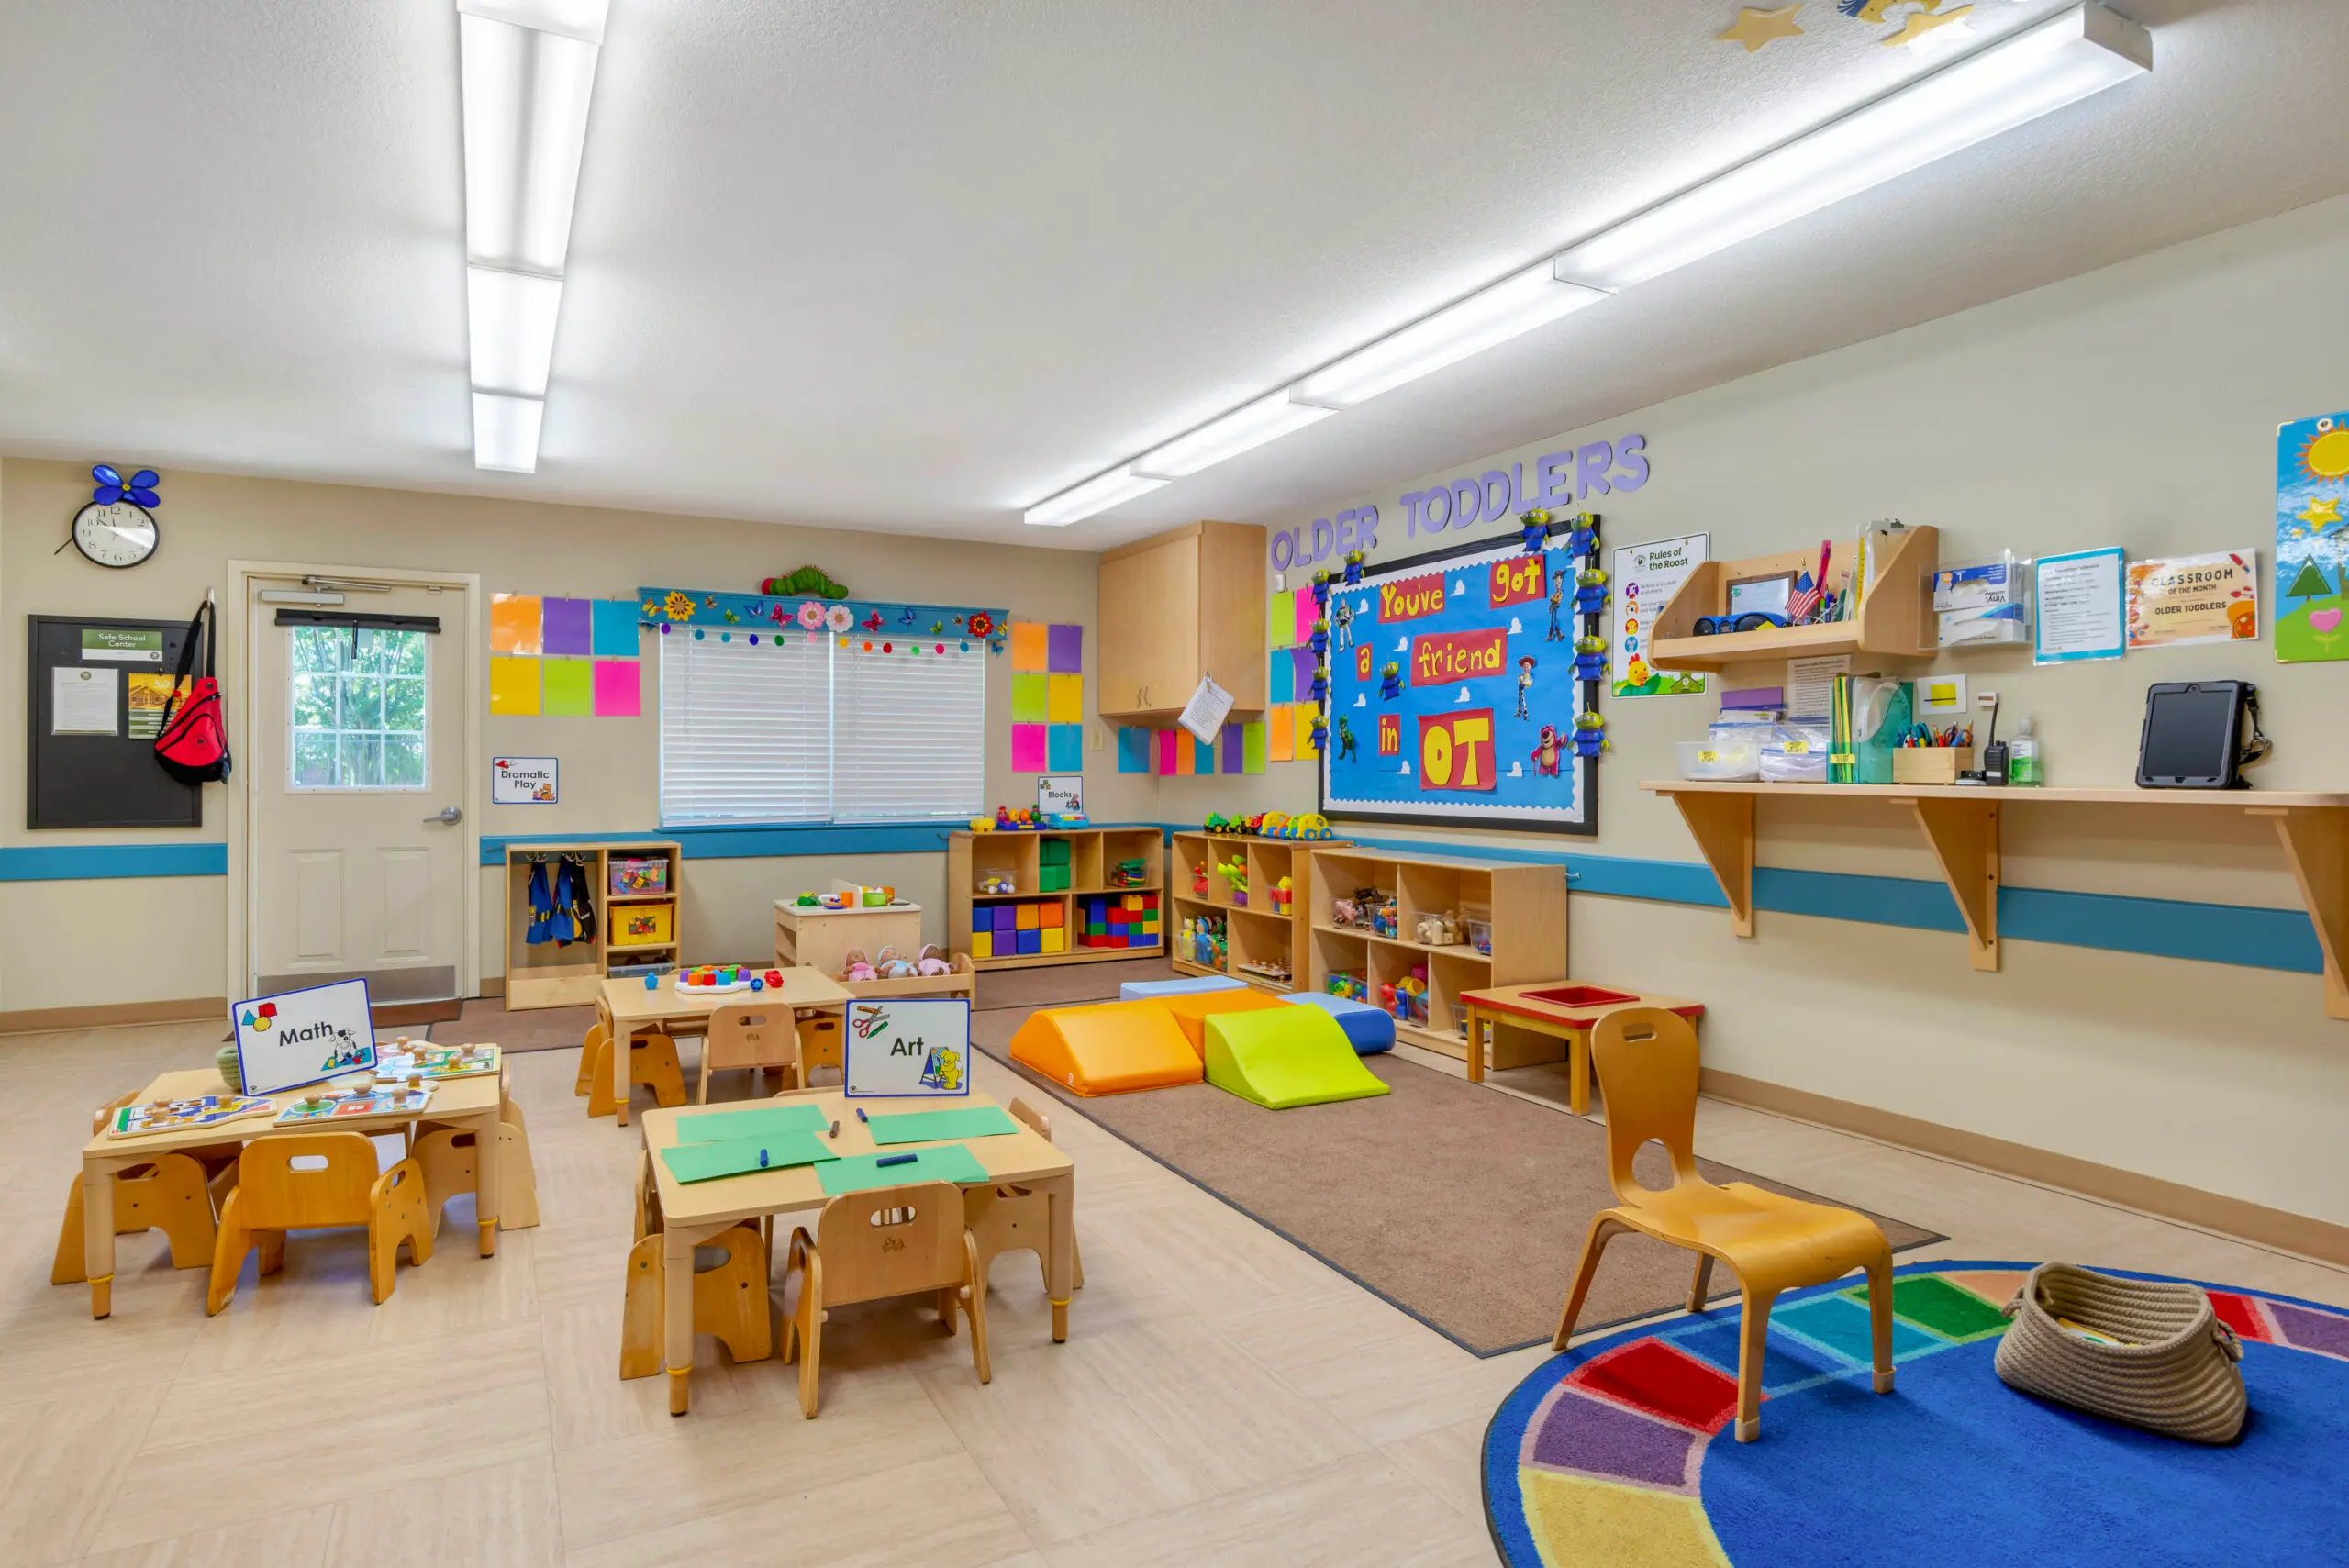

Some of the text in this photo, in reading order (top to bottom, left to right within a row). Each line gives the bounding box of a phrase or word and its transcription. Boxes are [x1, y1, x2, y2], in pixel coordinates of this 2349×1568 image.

[1271, 434, 1649, 572] OLDER TODDLERS
[110, 506, 121, 515] 12
[1649, 547, 1682, 561] Rules of
[1649, 561, 1663, 571] the
[1664, 557, 1688, 569] Roost
[1492, 558, 1541, 603] got
[2151, 569, 2233, 586] CLASSROOM
[2193, 584, 2217, 593] MONTH
[1986, 595, 2006, 605] Vinyl
[2155, 601, 2227, 615] OLDER TODDLERS
[1360, 639, 1501, 678] a friend
[1381, 717, 1489, 786] in OT
[501, 770, 550, 779] Dramatic
[514, 780, 536, 790] Play
[279, 1021, 334, 1047] Math
[890, 1037, 924, 1056] Art
